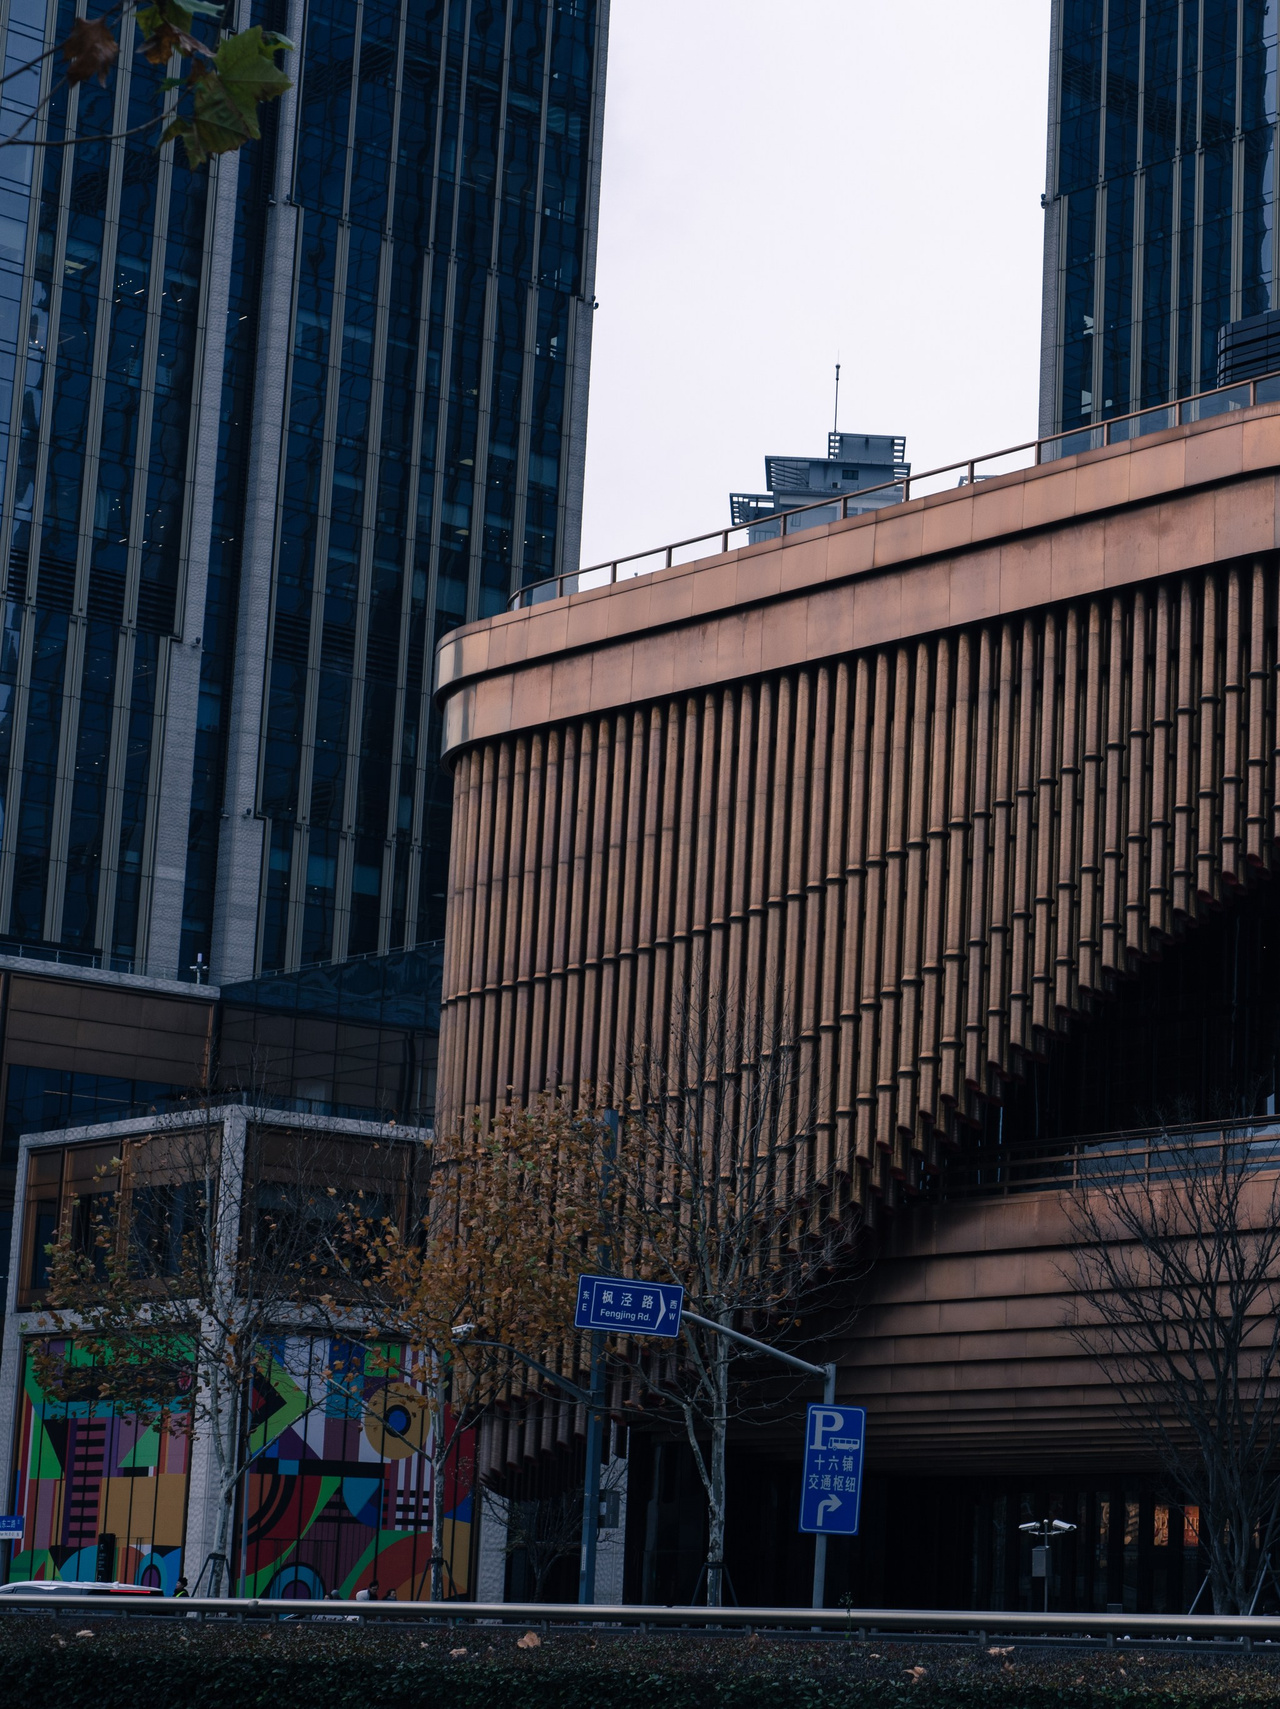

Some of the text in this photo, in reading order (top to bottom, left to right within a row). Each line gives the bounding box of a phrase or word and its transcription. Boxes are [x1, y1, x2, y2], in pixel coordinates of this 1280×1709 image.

[582, 1290, 590, 1300] 东
[602, 1290, 654, 1309] 枫泾路
[582, 1303, 588, 1312] E
[669, 1299, 678, 1310] 西
[600, 1308, 651, 1321] Fengjing Rd.
[668, 1313, 676, 1321] W
[809, 1410, 845, 1451] P
[814, 1454, 854, 1472] 十六铺
[808, 1474, 856, 1493] 交通枢纽
